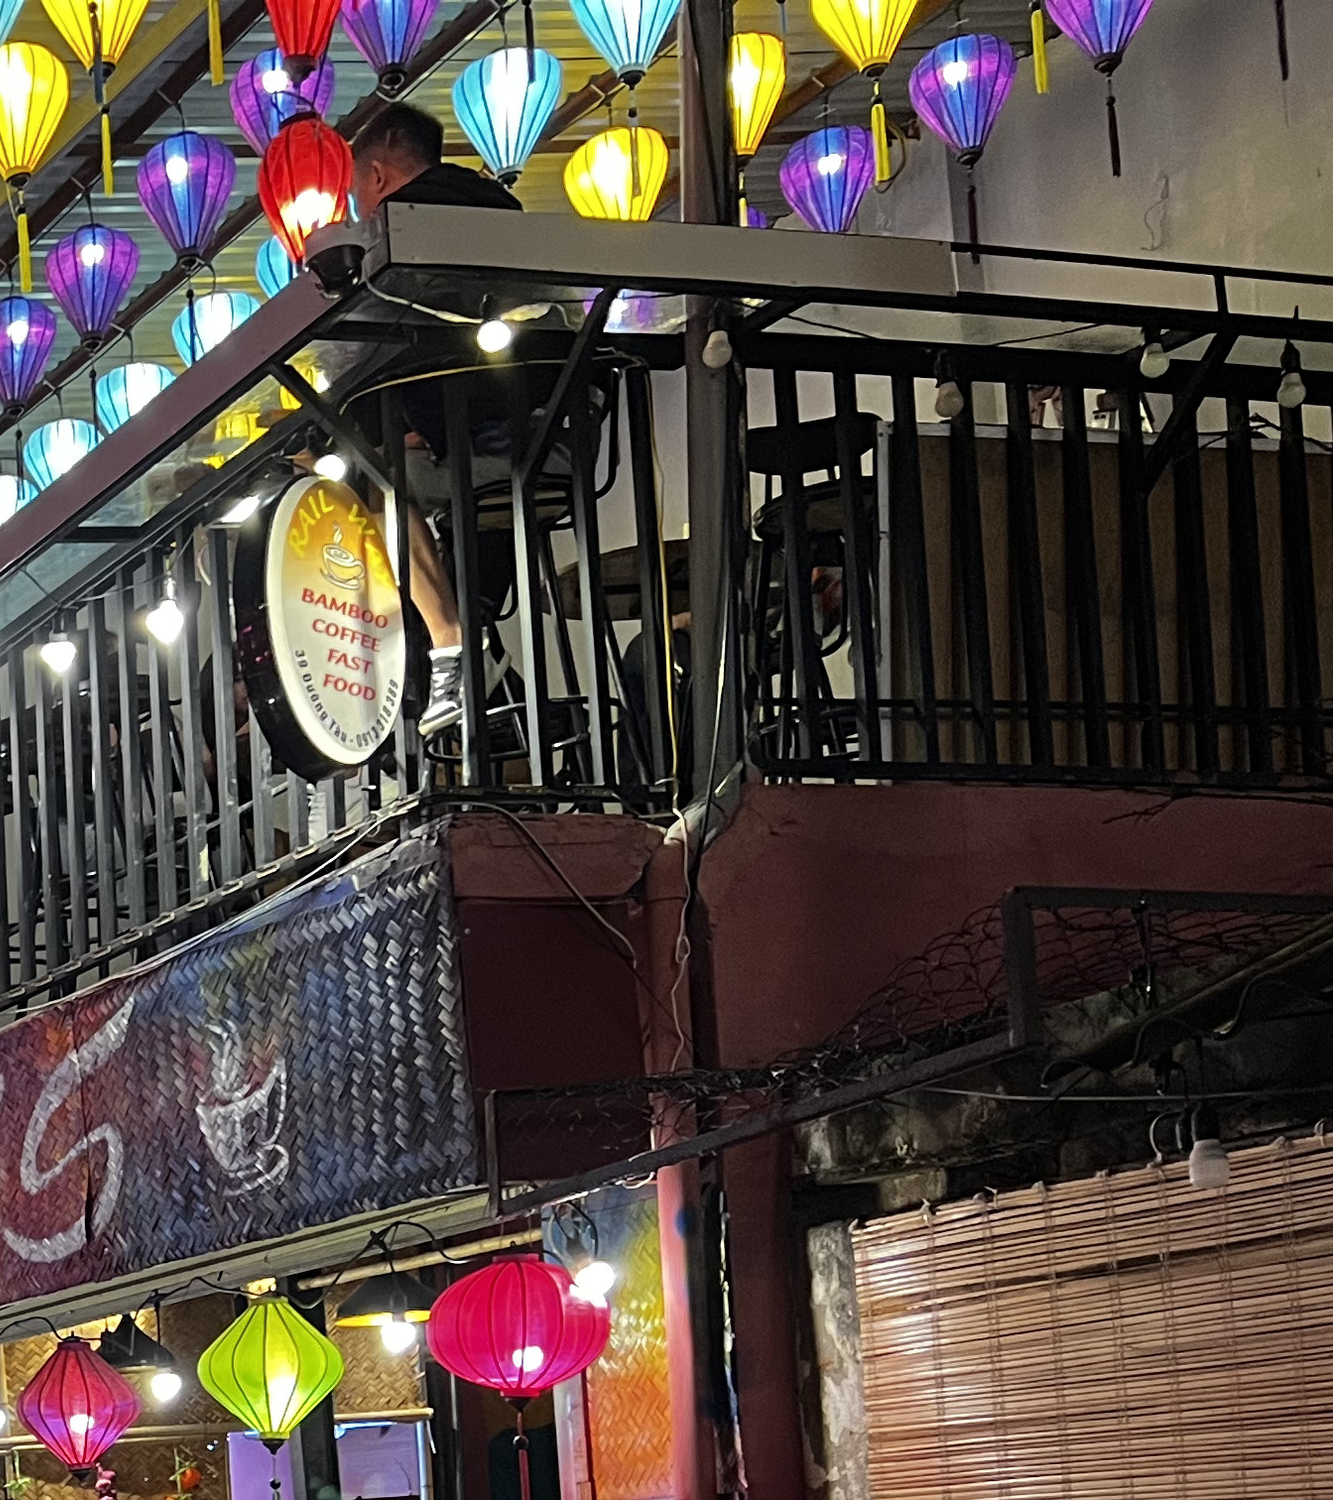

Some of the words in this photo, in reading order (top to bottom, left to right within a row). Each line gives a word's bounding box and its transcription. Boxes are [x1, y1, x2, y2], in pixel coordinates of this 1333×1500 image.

[289, 488, 334, 558] RAIL
[301, 587, 389, 630] BAMBOO
[311, 618, 382, 654] COFFEE
[326, 647, 374, 675] FAST
[322, 673, 377, 702] FOOD
